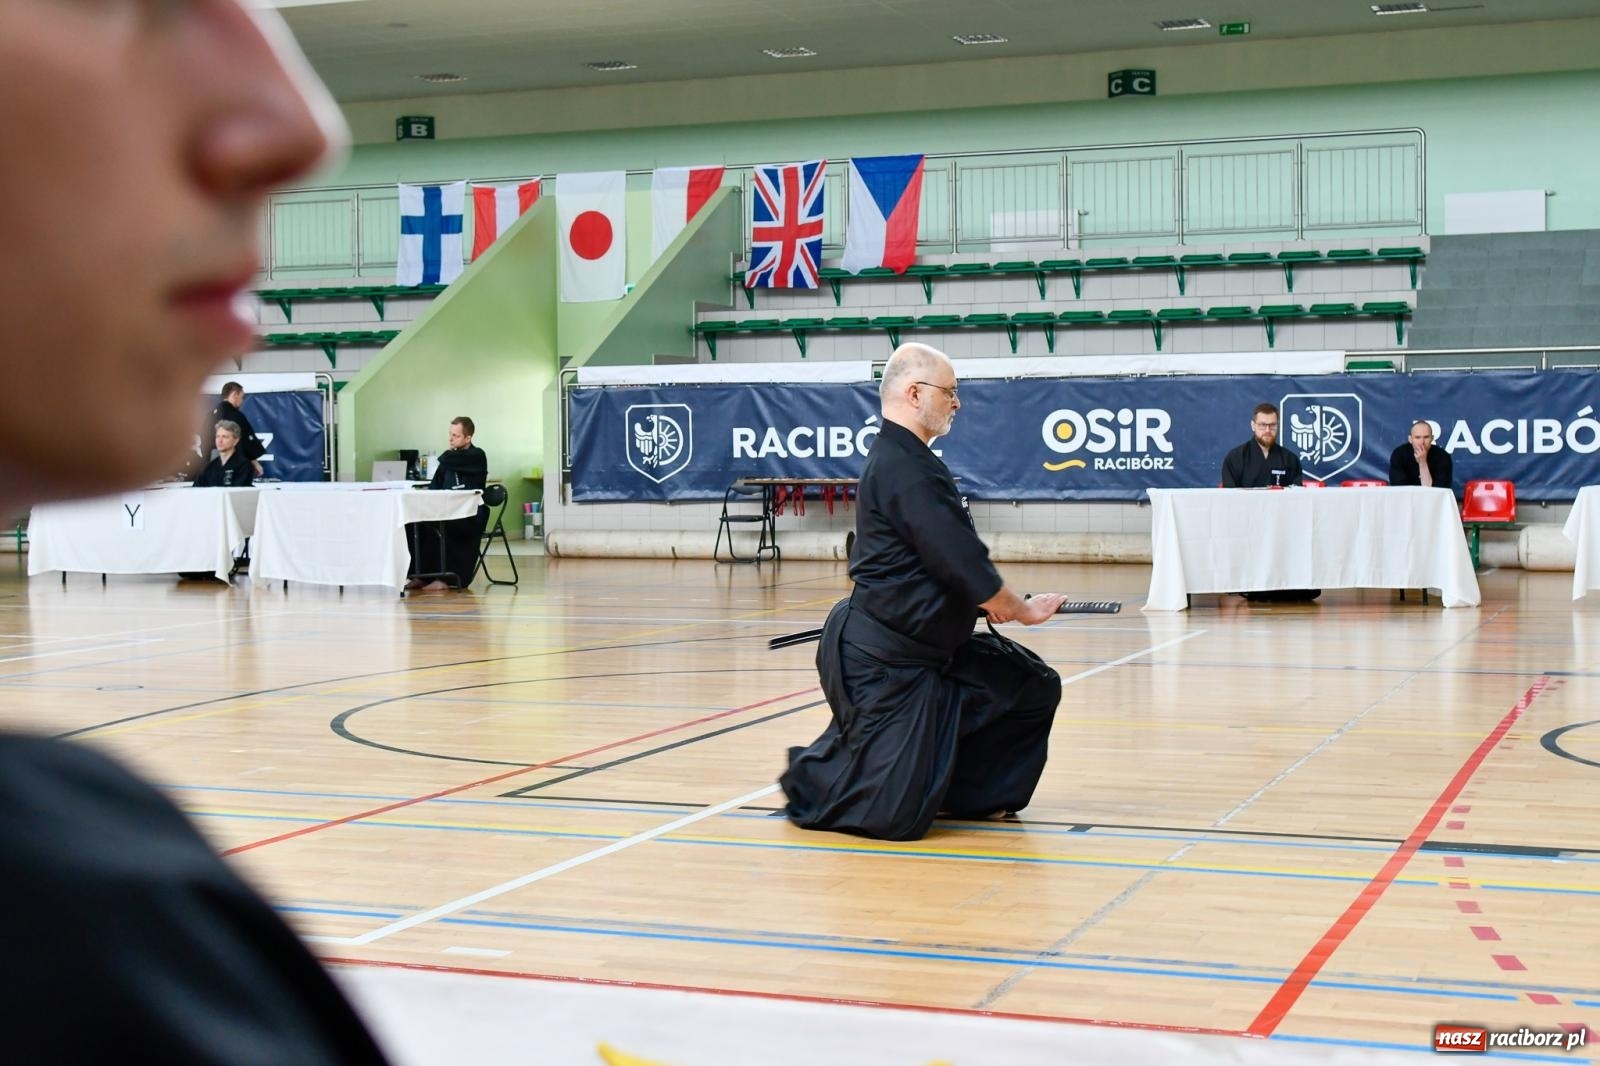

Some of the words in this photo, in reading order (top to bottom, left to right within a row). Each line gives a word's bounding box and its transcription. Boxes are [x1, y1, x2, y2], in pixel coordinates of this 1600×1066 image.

[1111, 79, 1122, 94] C
[1132, 77, 1151, 92] C
[411, 123, 428, 137] B
[1094, 454, 1174, 470] RACIBÓRZ
[124, 503, 141, 527] Y
